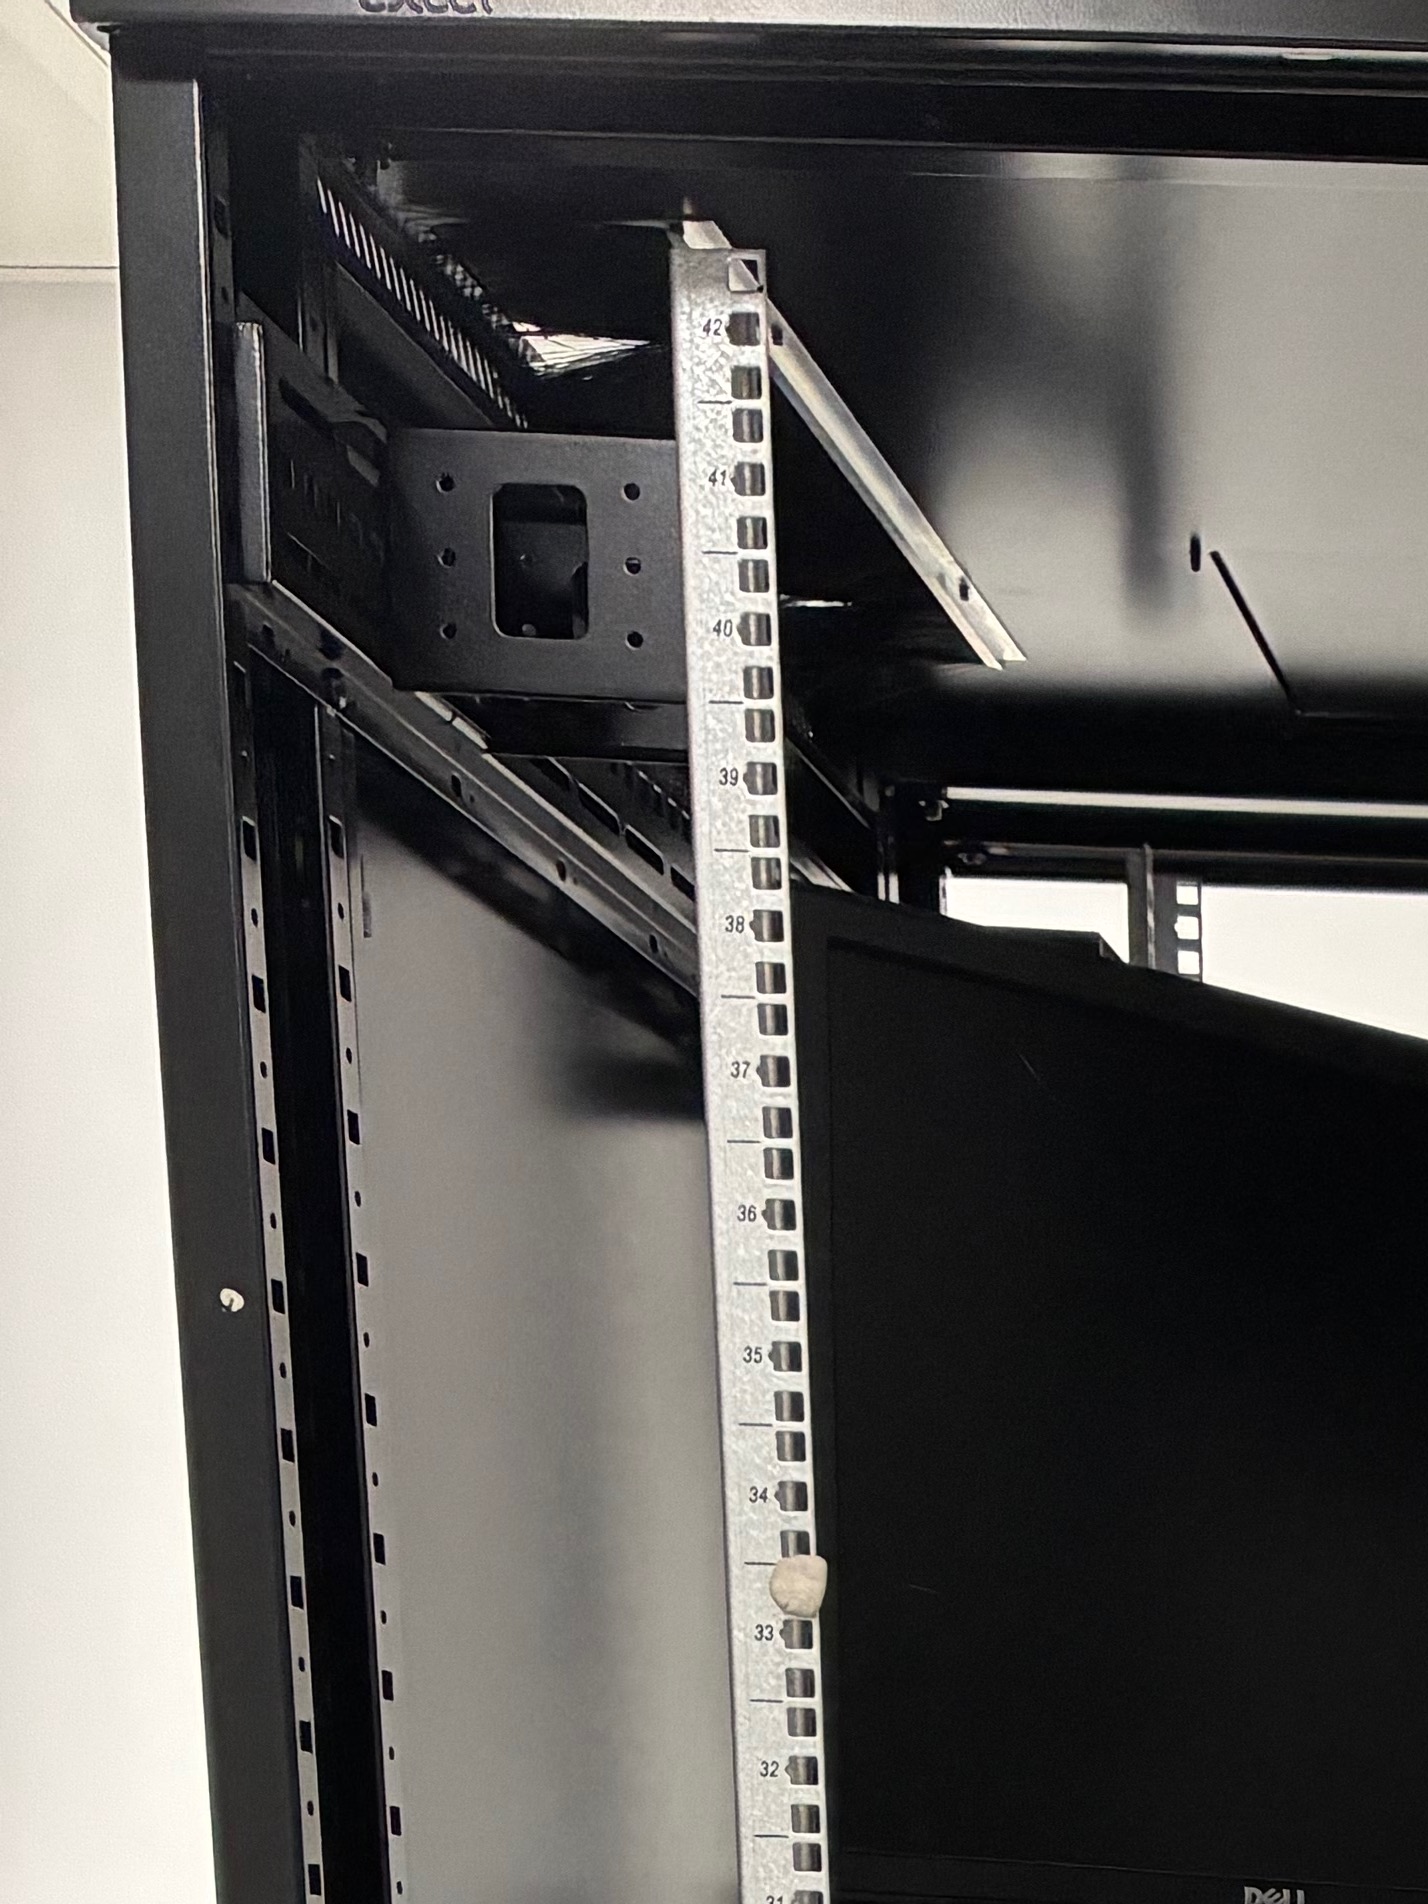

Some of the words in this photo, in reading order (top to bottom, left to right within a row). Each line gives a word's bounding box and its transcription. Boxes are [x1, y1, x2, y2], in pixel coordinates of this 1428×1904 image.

[702, 318, 722, 336] 42
[708, 468, 727, 486] 41
[713, 619, 733, 638] 40
[718, 767, 739, 787] 39
[724, 915, 745, 934] 38
[730, 1060, 751, 1079] 37
[736, 1205, 757, 1223] 36
[742, 1346, 763, 1364] 35
[749, 1487, 769, 1505] 34
[754, 1624, 775, 1642] 33
[759, 1760, 780, 1778] 32
